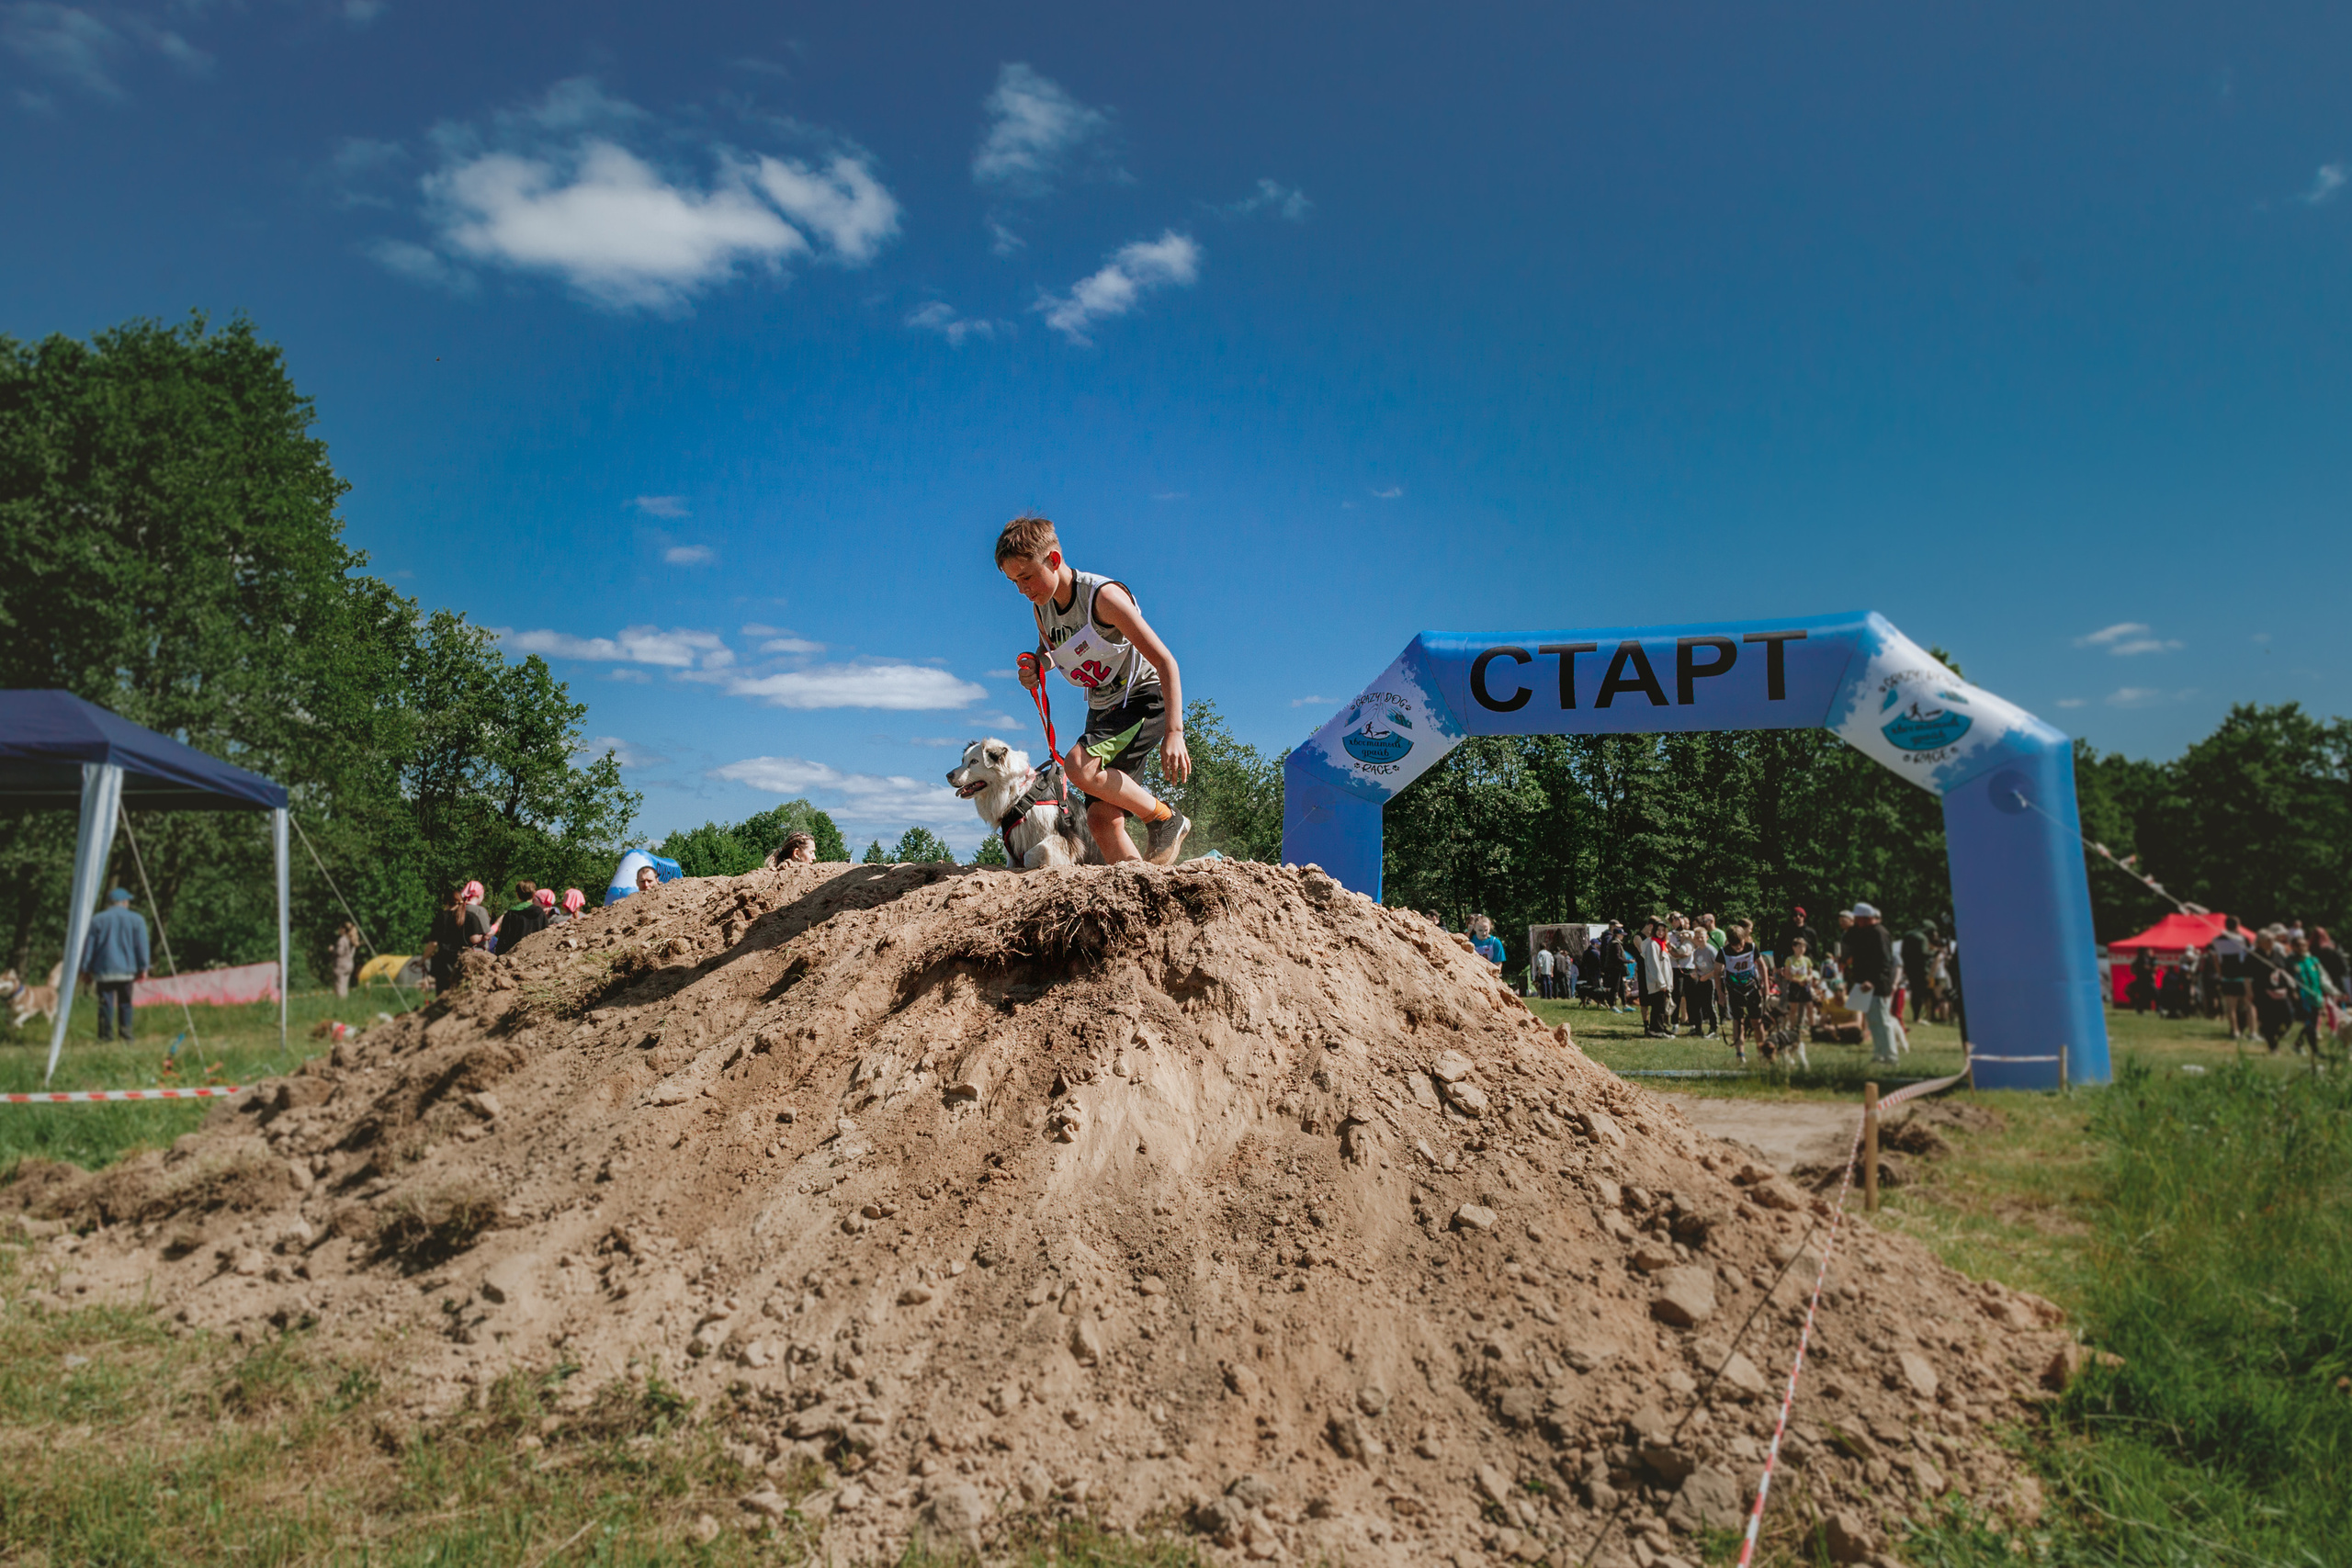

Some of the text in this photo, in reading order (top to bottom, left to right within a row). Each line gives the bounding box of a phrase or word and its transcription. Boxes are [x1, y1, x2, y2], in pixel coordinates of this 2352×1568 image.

[1070, 660, 1113, 688] 32
[1469, 629, 1807, 713] СТАРТ
[1355, 692, 1408, 707] CRAZY DOG
[1362, 763, 1393, 775] RACE
[1734, 961, 1747, 971] 40
